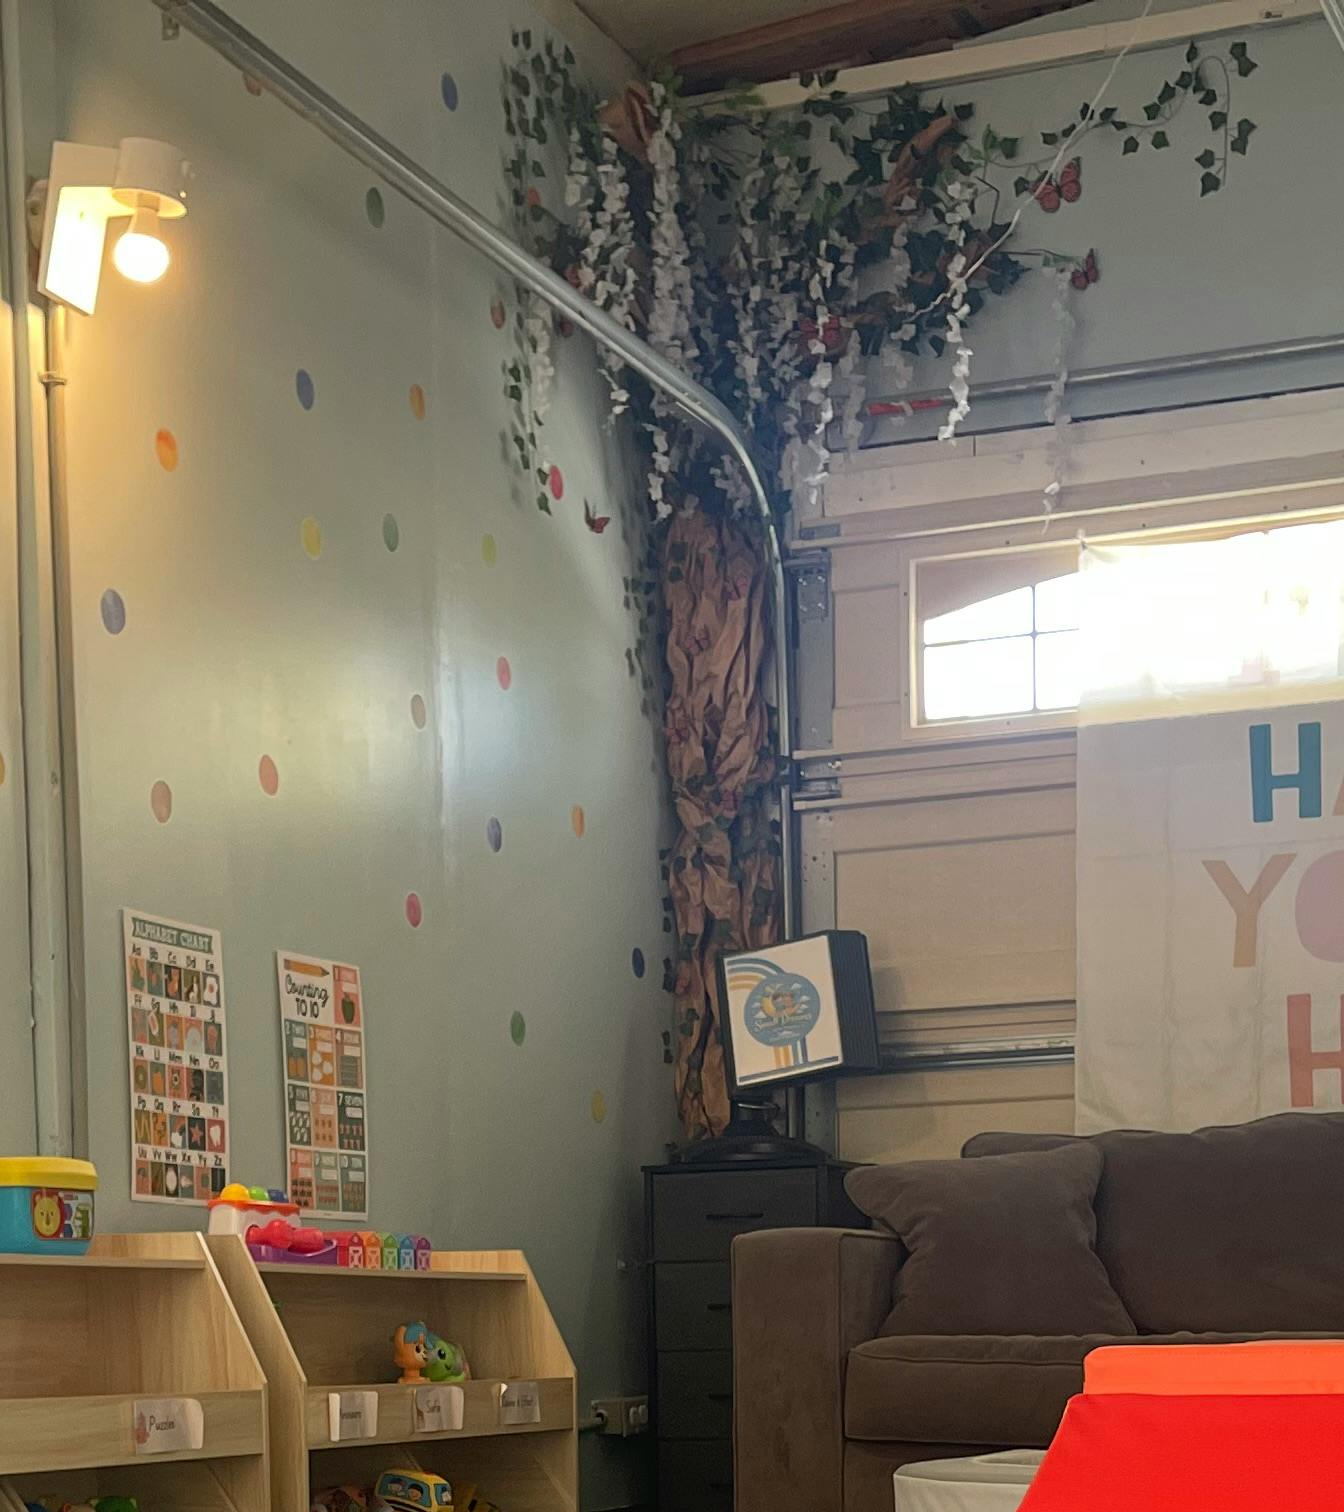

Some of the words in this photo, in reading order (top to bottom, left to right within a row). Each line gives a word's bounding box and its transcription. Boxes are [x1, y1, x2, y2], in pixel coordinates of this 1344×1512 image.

[136, 920, 178, 945] ALPHABET
[180, 932, 209, 953] CHART
[285, 973, 329, 1008] Counting
[295, 997, 308, 1017] TO
[310, 1000, 319, 1018] 10
[149, 1415, 175, 1432] Puzzles
